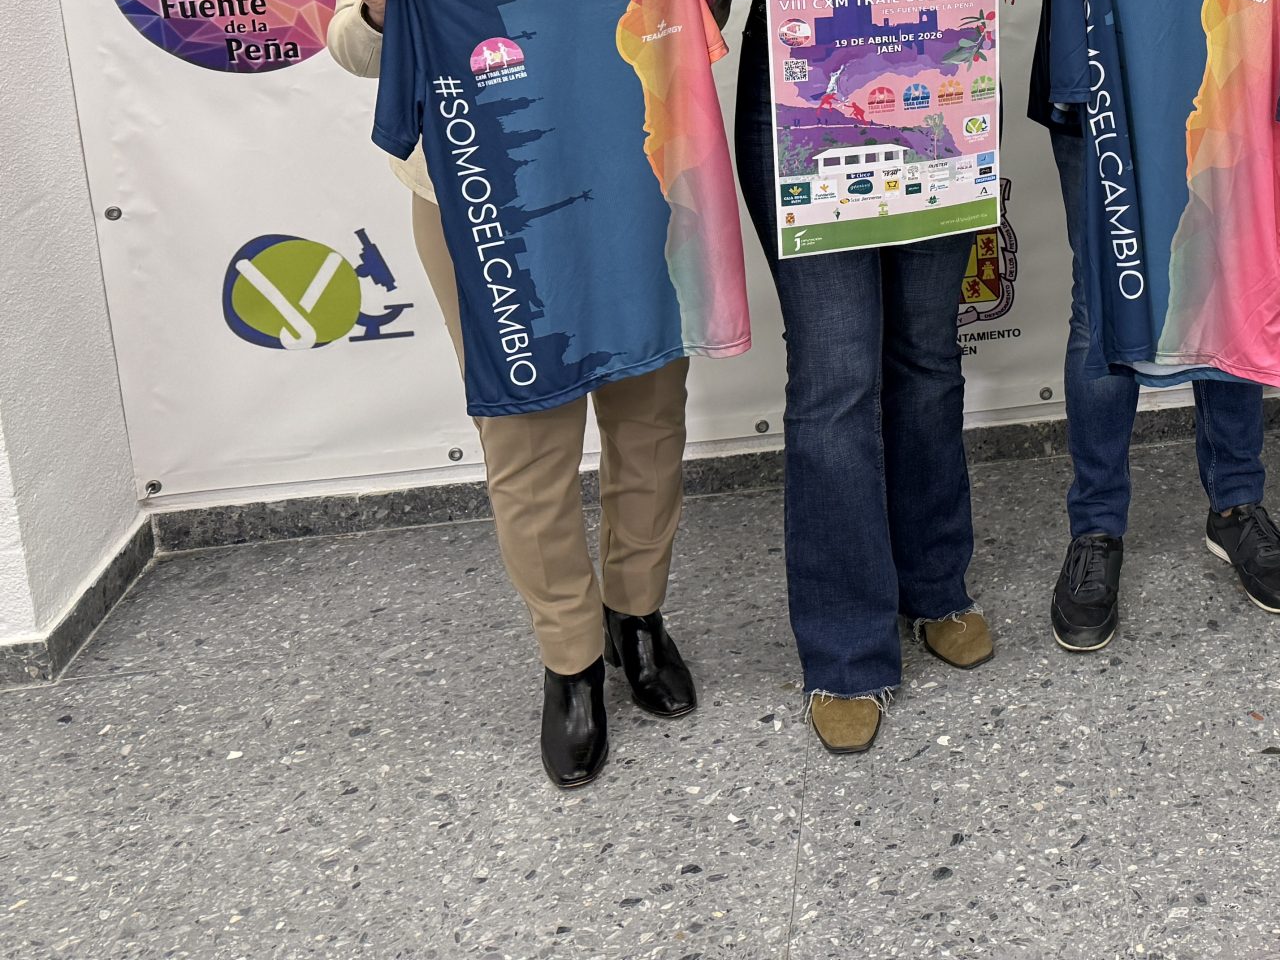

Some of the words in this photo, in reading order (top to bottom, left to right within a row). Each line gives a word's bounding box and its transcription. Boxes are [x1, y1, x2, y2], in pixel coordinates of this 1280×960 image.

[779, 0, 806, 11] VIII
[224, 20, 247, 34] de
[251, 19, 268, 33] la
[641, 25, 683, 43] TEAMERGY
[835, 39, 848, 48] 19
[851, 38, 865, 46] DE
[868, 35, 898, 45] ABRIL
[900, 34, 915, 42] DE
[917, 31, 943, 40] 2026
[225, 37, 300, 63] Peña
[877, 44, 902, 55] JAÉN
[433, 75, 537, 386] #SOMOSELCAMBIO
[957, 328, 1021, 343] NTAMIENTO
